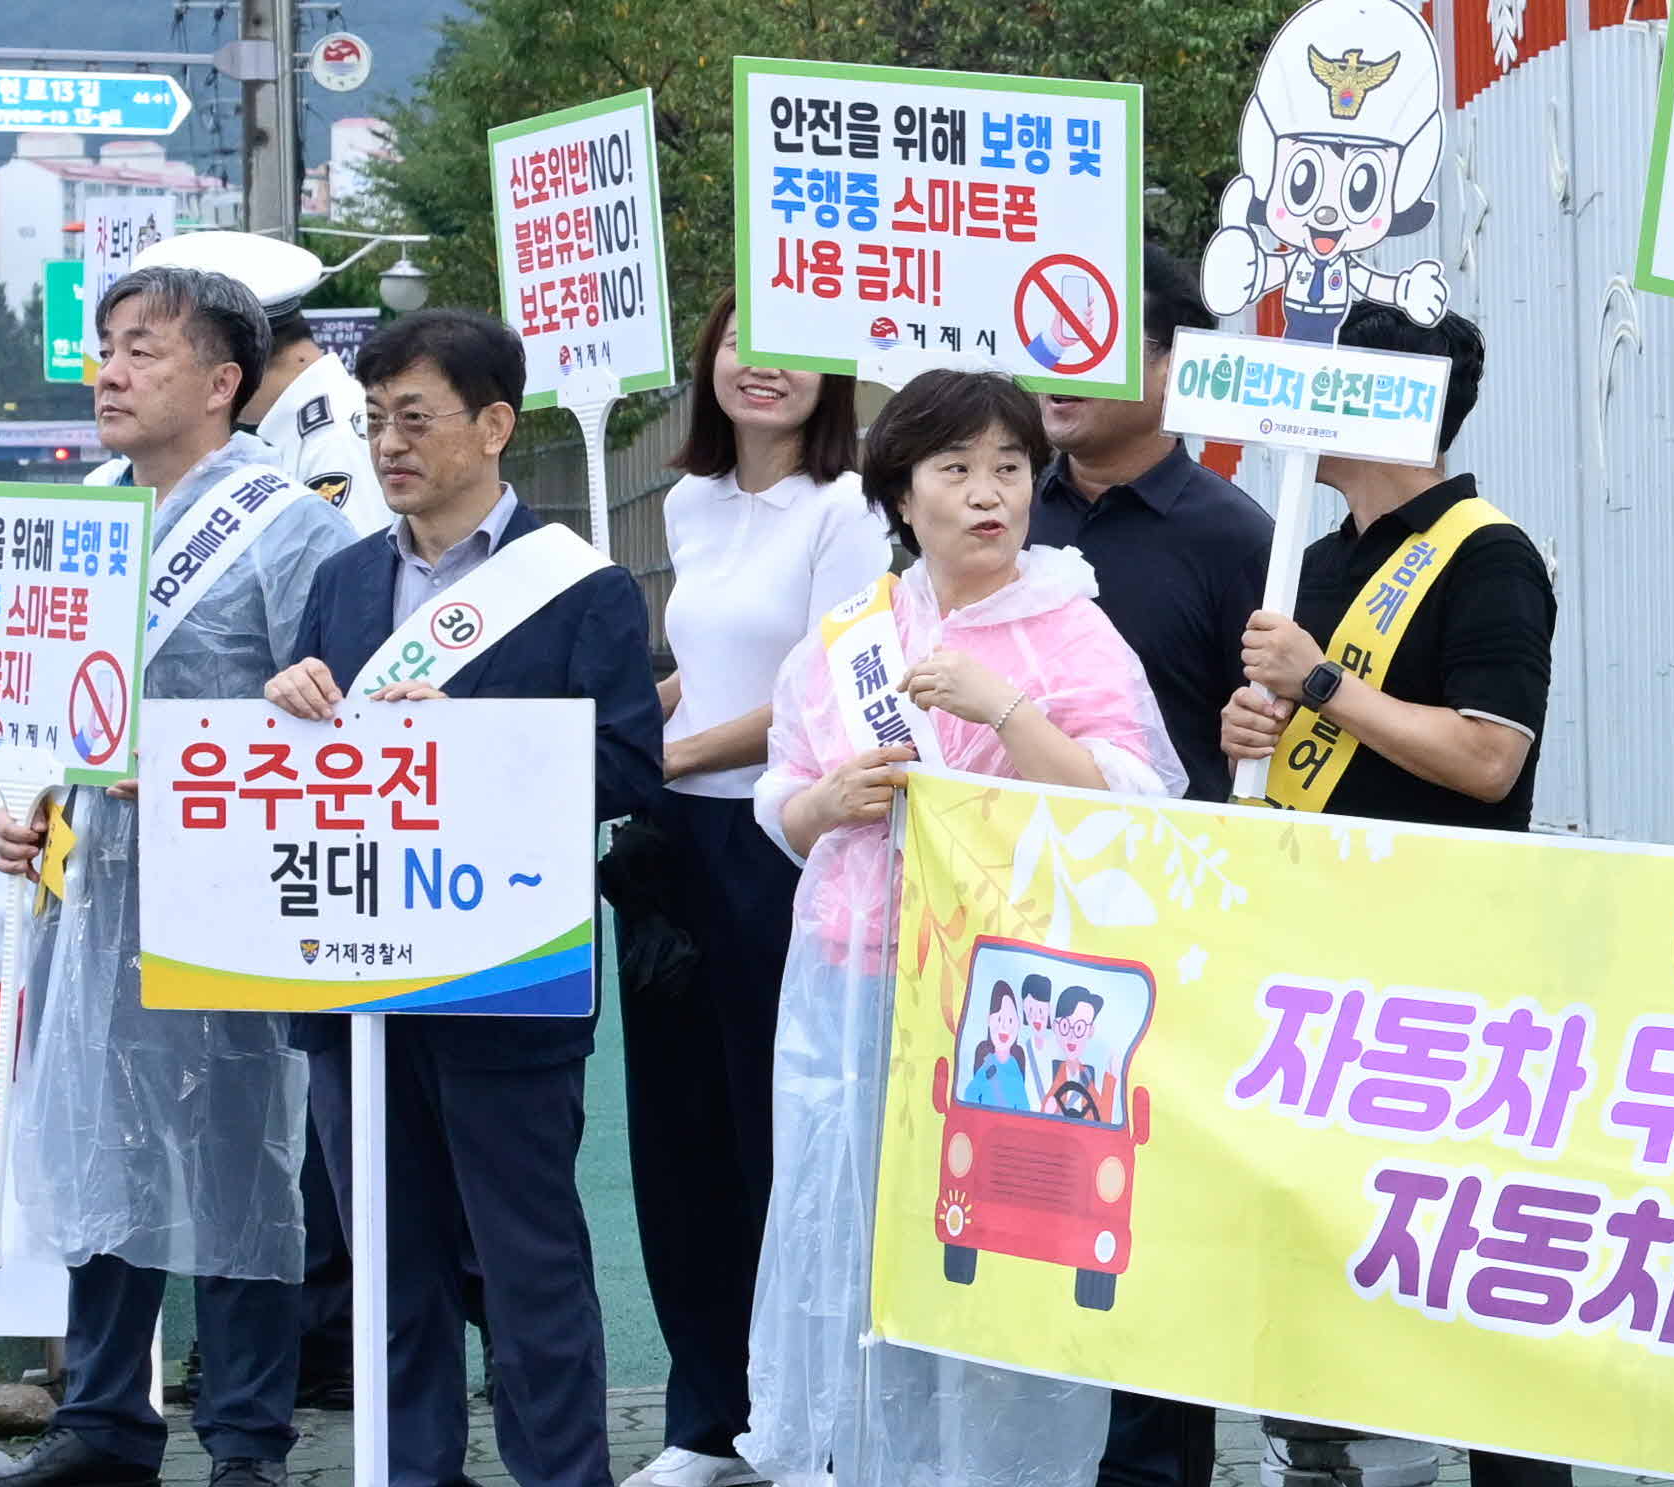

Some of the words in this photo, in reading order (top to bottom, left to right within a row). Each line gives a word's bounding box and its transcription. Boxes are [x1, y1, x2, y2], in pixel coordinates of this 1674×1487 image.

[770, 95, 881, 160] 안전을
[893, 104, 966, 165] 위해
[980, 111, 1052, 178] 보행
[1066, 118, 1101, 178] 및
[771, 166, 880, 232] 주행중
[892, 176, 1038, 243] 스마트폰
[771, 237, 844, 300] 사용
[855, 243, 941, 307] 금지!
[906, 322, 997, 356] 거제시
[1178, 353, 1305, 410] 아이먼저
[1310, 366, 1438, 423] 안전먼저
[11, 517, 54, 572] 위해
[59, 519, 102, 577] 보행
[108, 521, 129, 577] 및
[150, 506, 241, 608] 만들어요
[6, 584, 88, 642] 스마트폰
[1366, 541, 1438, 636] 함께
[438, 609, 475, 643] 30
[850, 643, 889, 700] 함께
[7, 722, 58, 750] 거제시
[171, 741, 441, 831] 음주운전
[269, 840, 379, 918] 절대
[404, 847, 484, 912] No
[324, 941, 414, 966] 거제경찰서
[1234, 984, 1588, 1150] 자동차
